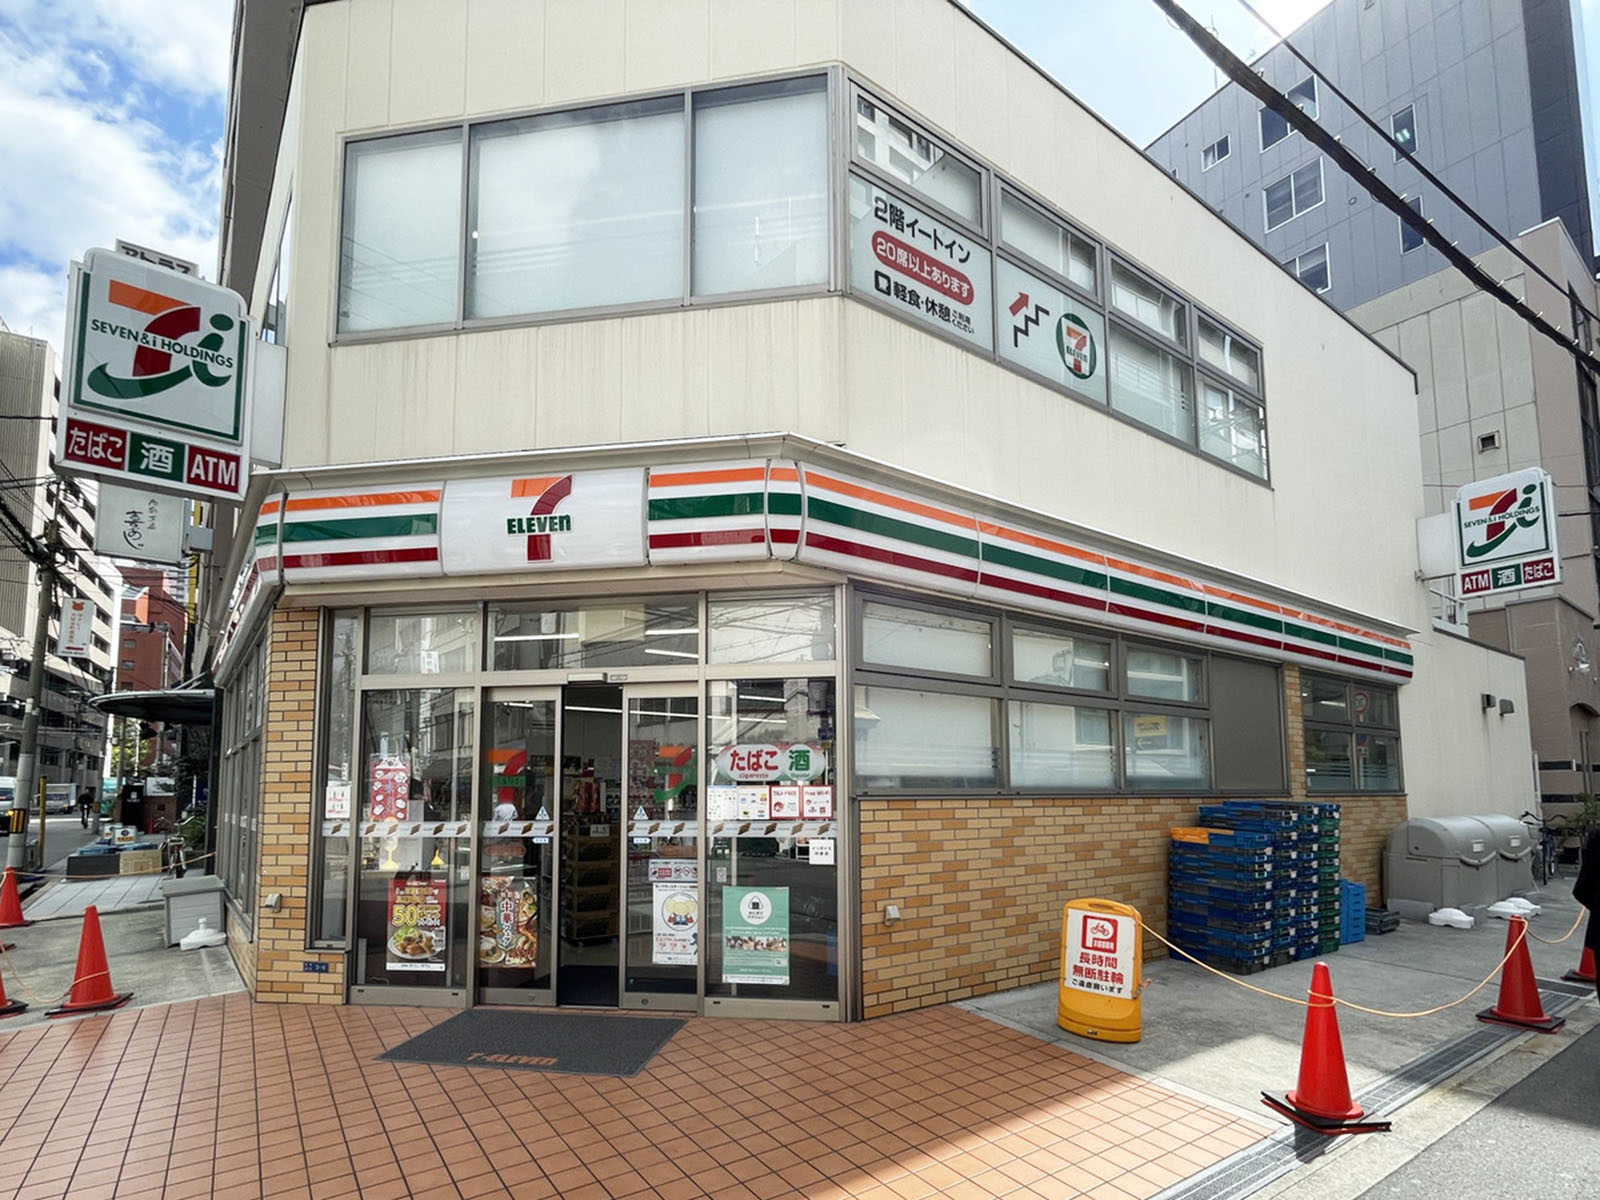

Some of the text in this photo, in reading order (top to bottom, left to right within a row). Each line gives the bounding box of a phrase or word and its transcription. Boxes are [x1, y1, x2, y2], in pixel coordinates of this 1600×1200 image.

[873, 195, 971, 263] 2階イートイン
[876, 237, 970, 298] 20席以上あります
[161, 338, 234, 369] HOLDINGS
[68, 427, 237, 487] たばこ 酒 ATM
[1498, 505, 1541, 522] HOLDINGS
[1463, 562, 1553, 592] ATM 酒 たばこ
[729, 749, 811, 772] たばこ 酒
[391, 904, 419, 927] 50
[1079, 952, 1118, 969] 長時間
[1072, 964, 1124, 985] 無断駐輪
